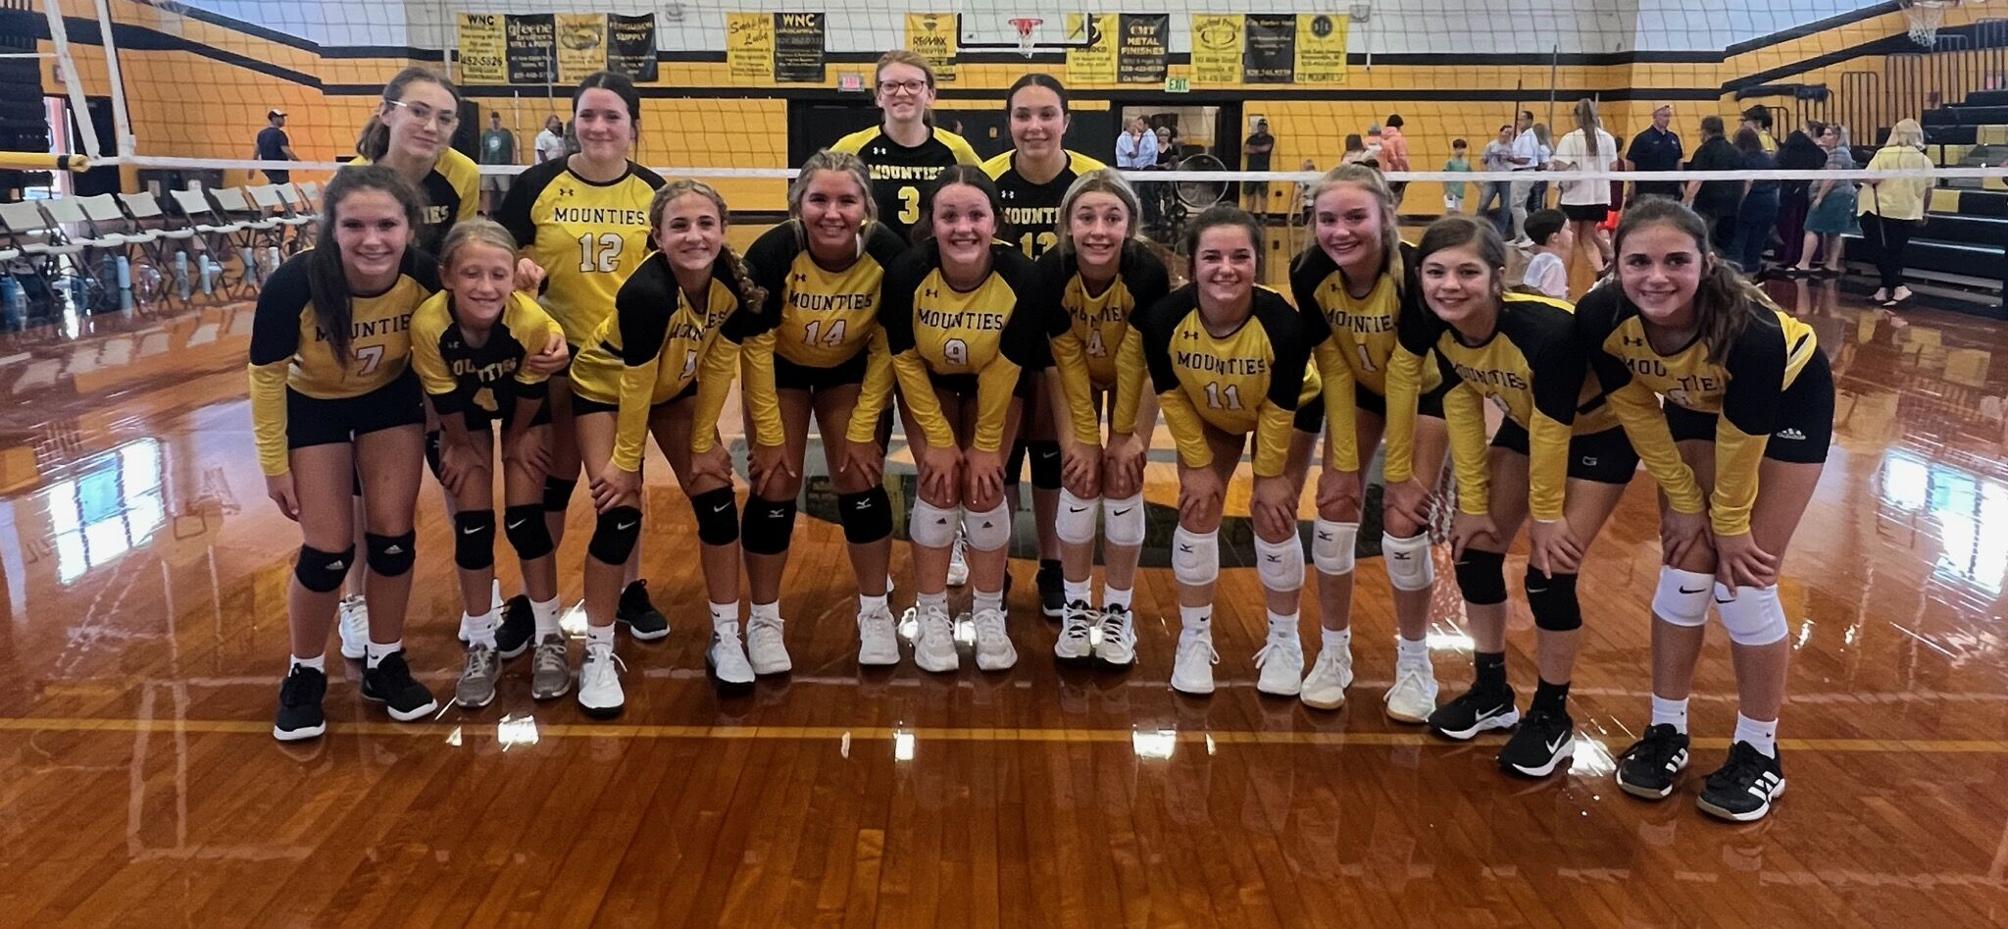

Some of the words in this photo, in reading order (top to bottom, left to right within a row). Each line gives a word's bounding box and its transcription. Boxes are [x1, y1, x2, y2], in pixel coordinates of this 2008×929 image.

[467, 15, 495, 26] WNC
[783, 13, 815, 28] WNC
[615, 33, 647, 41] SUPPLY
[1127, 37, 1159, 46] METAL
[1121, 47, 1165, 55] FINISHES
[1169, 79, 1187, 90] EXIT
[554, 207, 646, 225] MOUNTIES
[898, 186, 920, 225] 3
[578, 232, 624, 274] 12
[788, 290, 874, 311] MOUNTIES
[315, 314, 411, 342] MUNTIE
[918, 308, 1003, 331] MOUNTIES
[802, 319, 847, 347] 14
[1086, 328, 1108, 358] 4
[356, 344, 385, 377] 7
[944, 337, 968, 366] 9
[1177, 351, 1266, 376] MOUNTIES
[1203, 381, 1246, 411] 11
